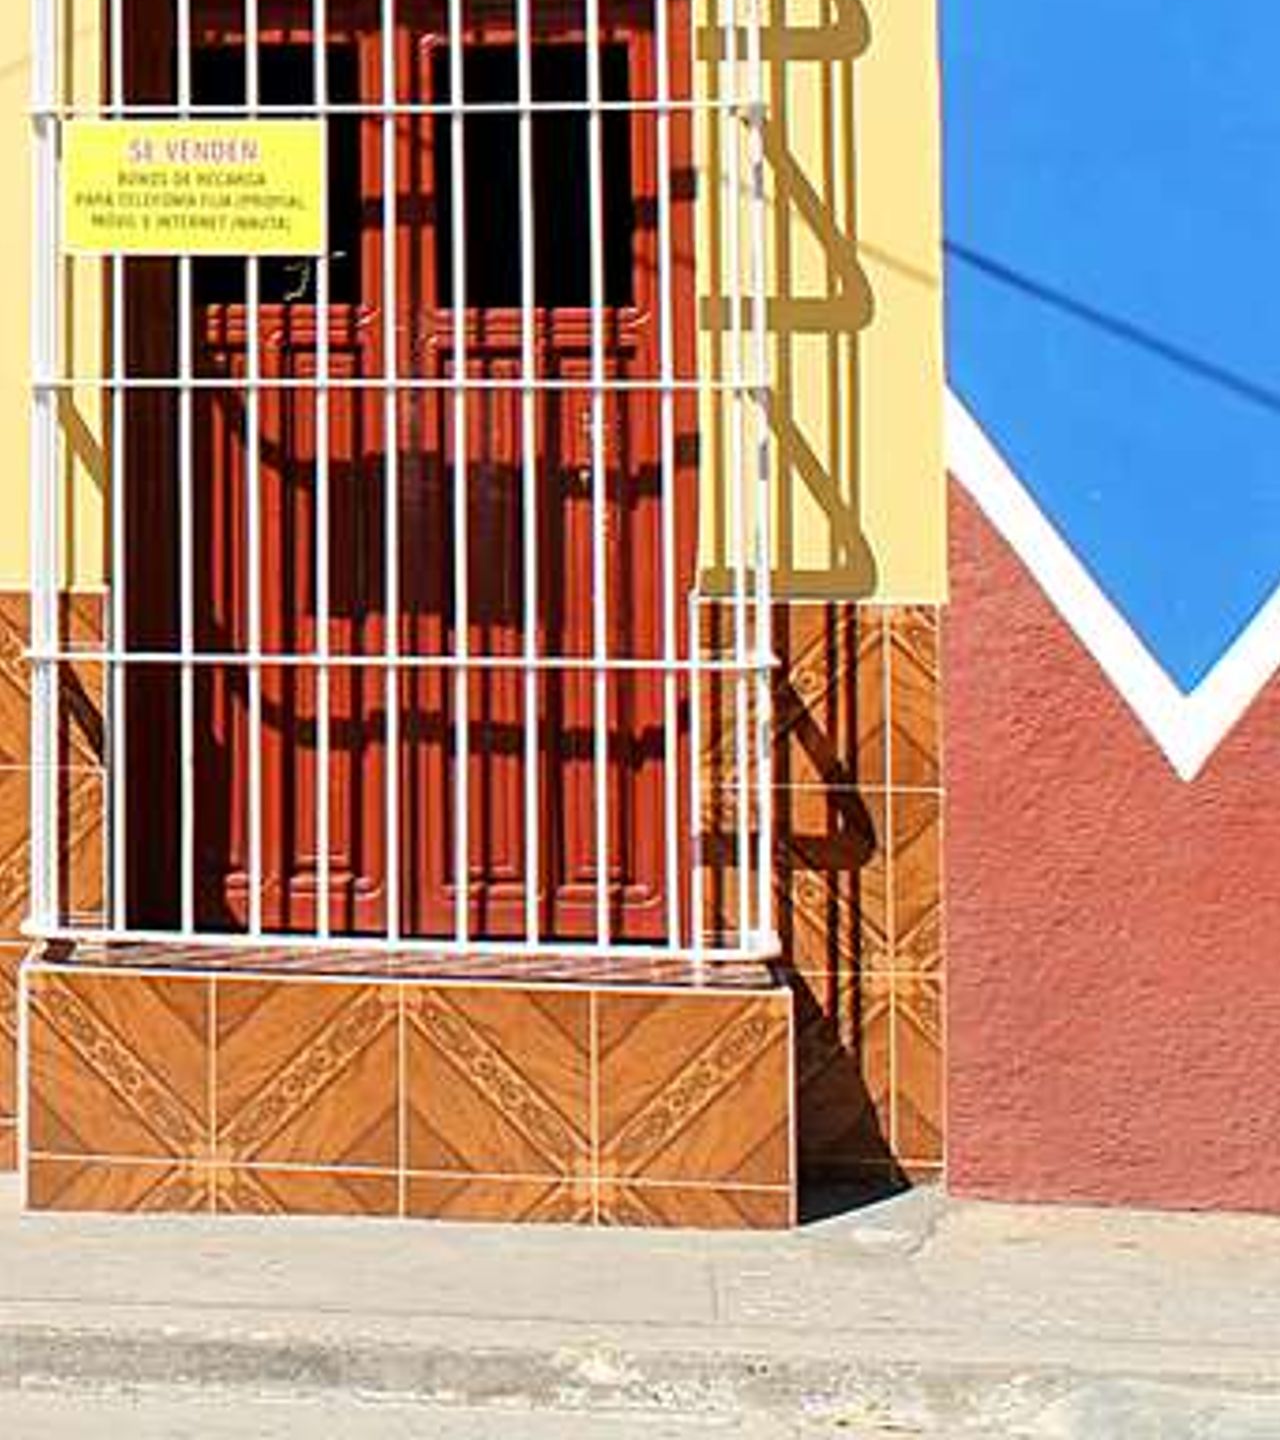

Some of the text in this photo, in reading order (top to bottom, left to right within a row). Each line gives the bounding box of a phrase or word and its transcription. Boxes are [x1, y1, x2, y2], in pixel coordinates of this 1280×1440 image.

[127, 139, 259, 164] SE VENDEN
[171, 170, 190, 187] DE
[75, 191, 114, 208] PARA
